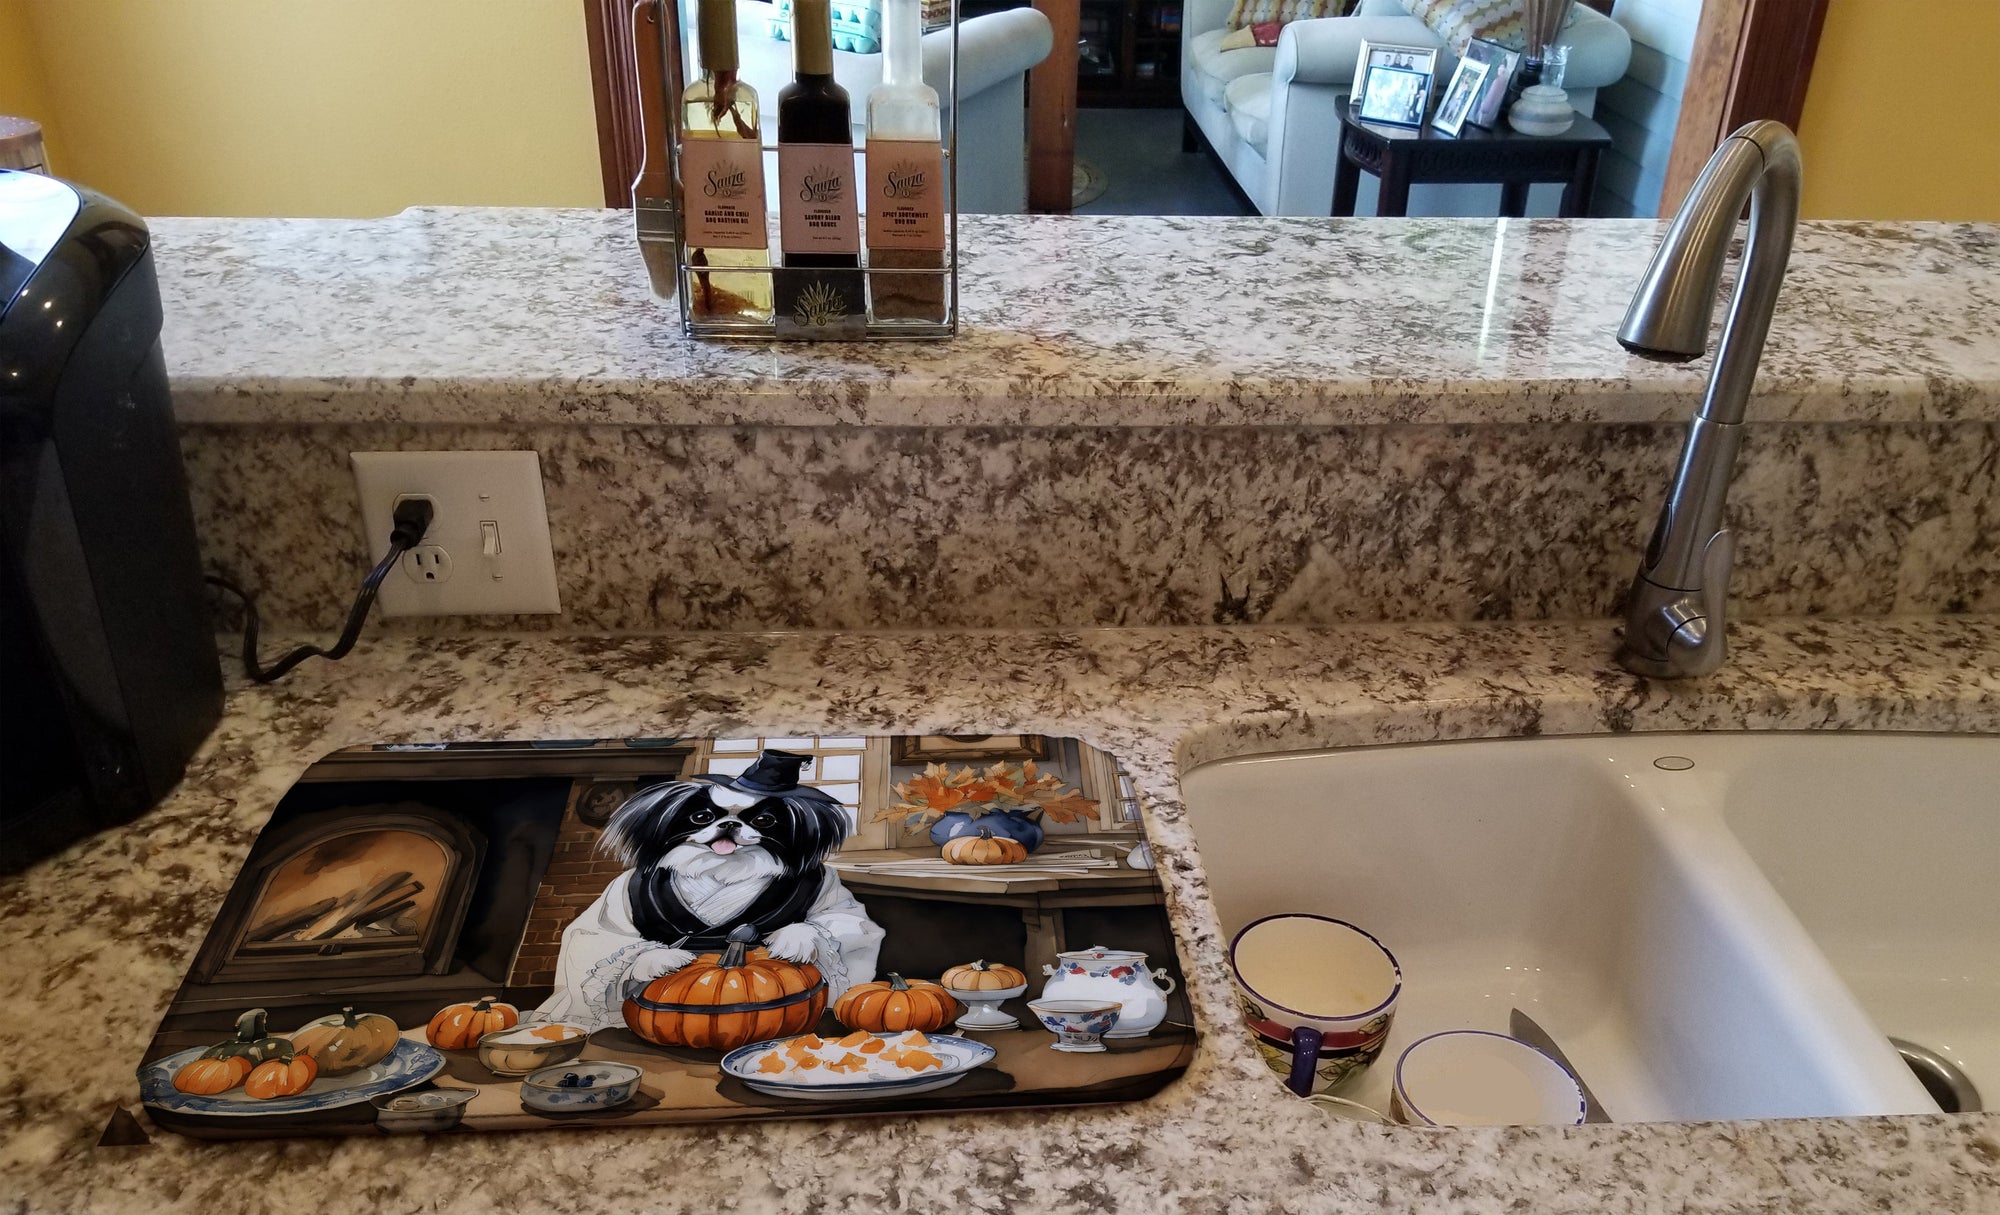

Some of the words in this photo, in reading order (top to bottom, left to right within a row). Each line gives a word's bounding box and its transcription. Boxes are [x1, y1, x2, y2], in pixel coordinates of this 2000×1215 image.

[704, 170, 745, 197] Sauza
[800, 175, 841, 202] Sauza
[884, 171, 925, 198] Sauza
